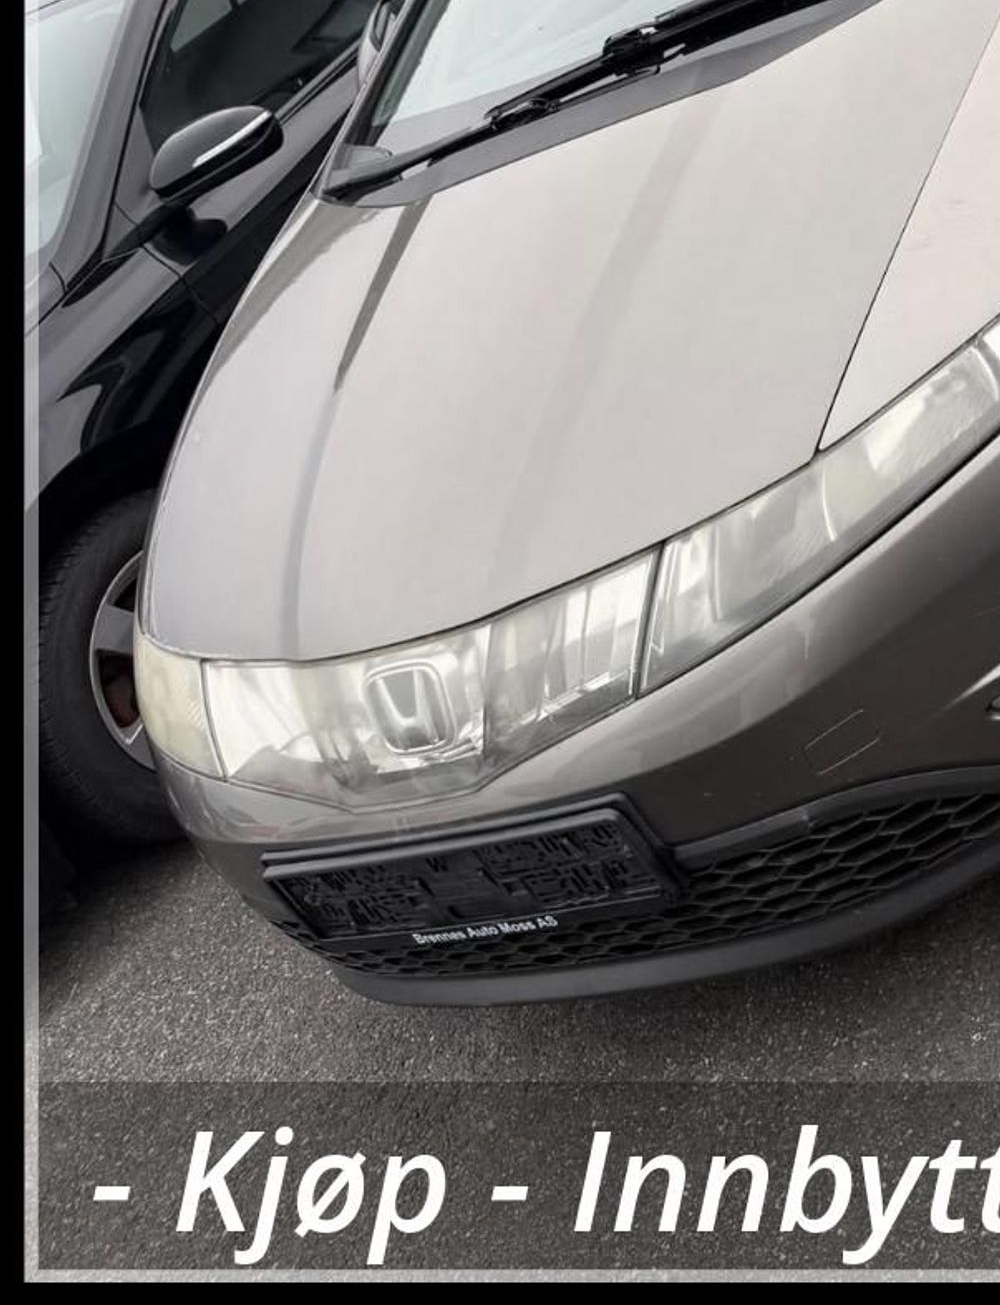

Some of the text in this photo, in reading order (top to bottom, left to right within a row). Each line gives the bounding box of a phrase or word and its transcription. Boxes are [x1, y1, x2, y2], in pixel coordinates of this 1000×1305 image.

[411, 915, 559, 945] Brennes Auto Moss AS
